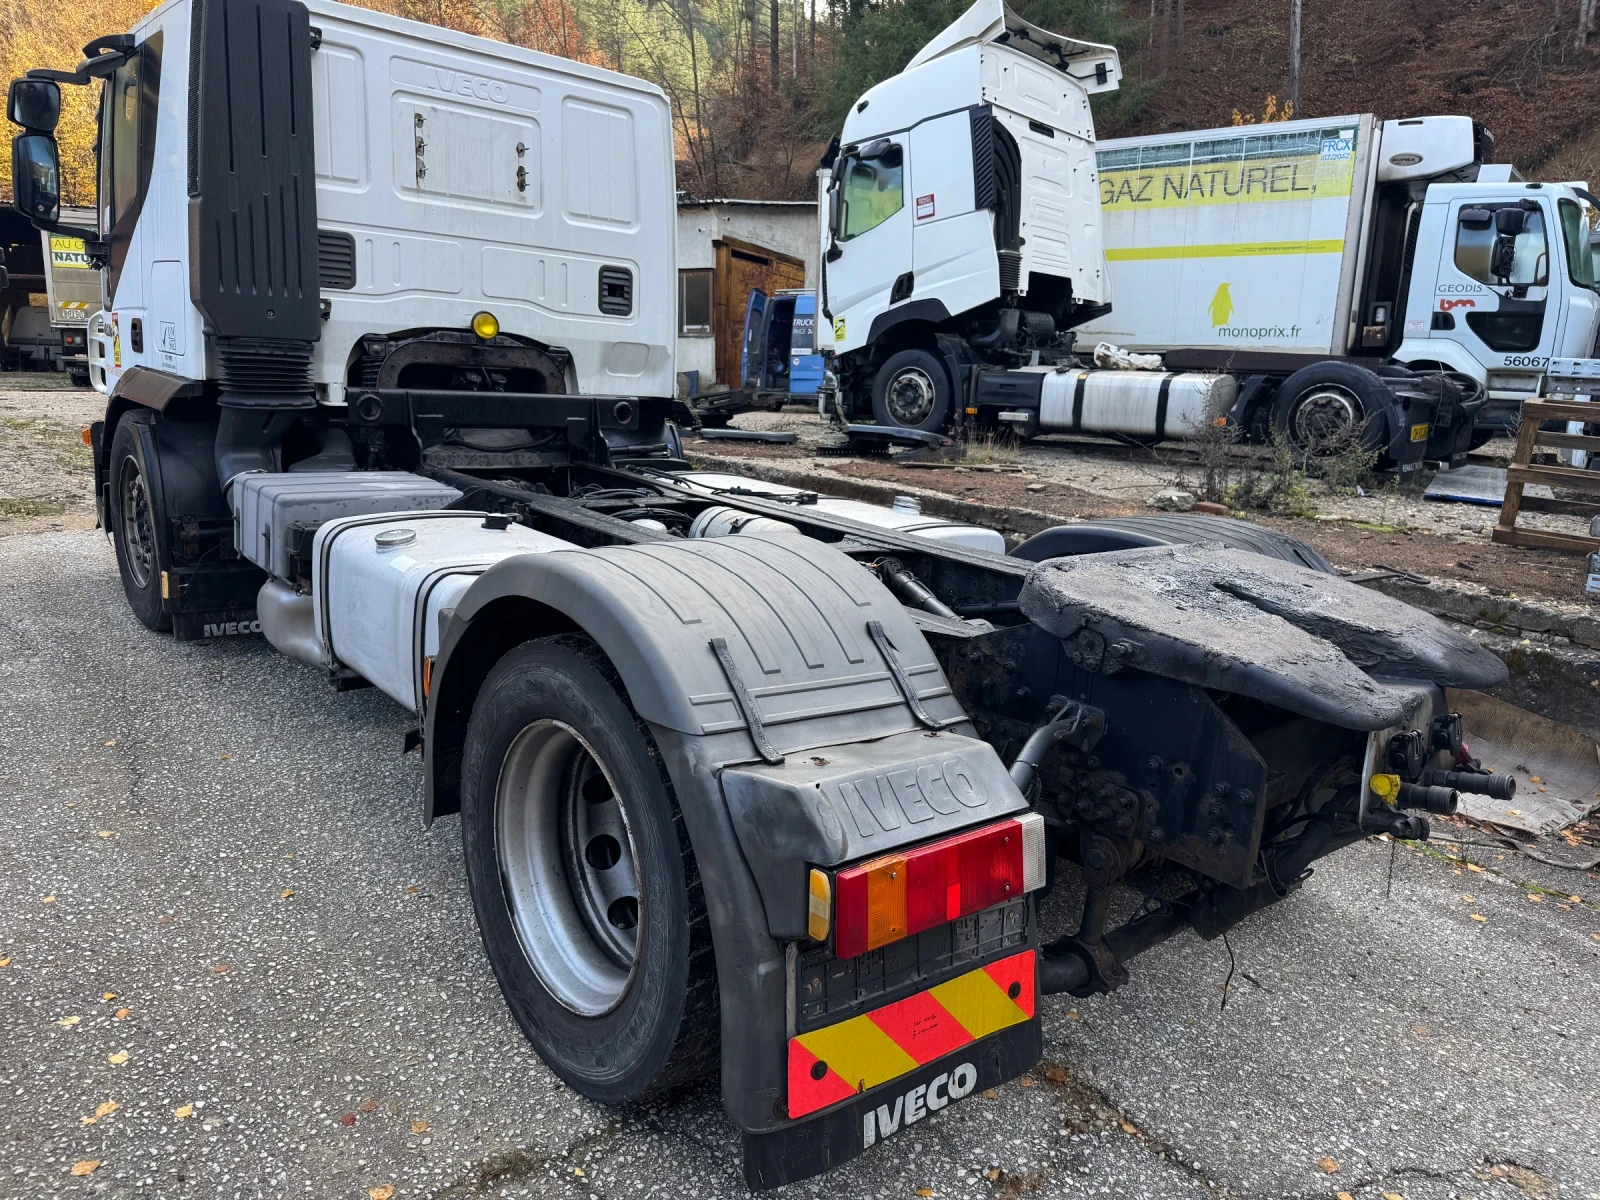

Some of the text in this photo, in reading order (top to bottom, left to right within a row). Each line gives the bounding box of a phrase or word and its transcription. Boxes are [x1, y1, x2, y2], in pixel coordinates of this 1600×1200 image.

[426, 66, 509, 104] IVECO
[1321, 139, 1350, 152] FRCX
[1098, 176, 1154, 205] GAZ
[54, 239, 71, 249] AU
[55, 252, 91, 264] NATU
[1438, 284, 1482, 293] GEODIS
[793, 318, 814, 327] TRUCK
[1218, 325, 1302, 340] monoprix.fr
[1503, 356, 1550, 368] 56067
[203, 620, 263, 637] IVECO
[838, 759, 988, 838] IVECO
[863, 1062, 978, 1149] IVECO
